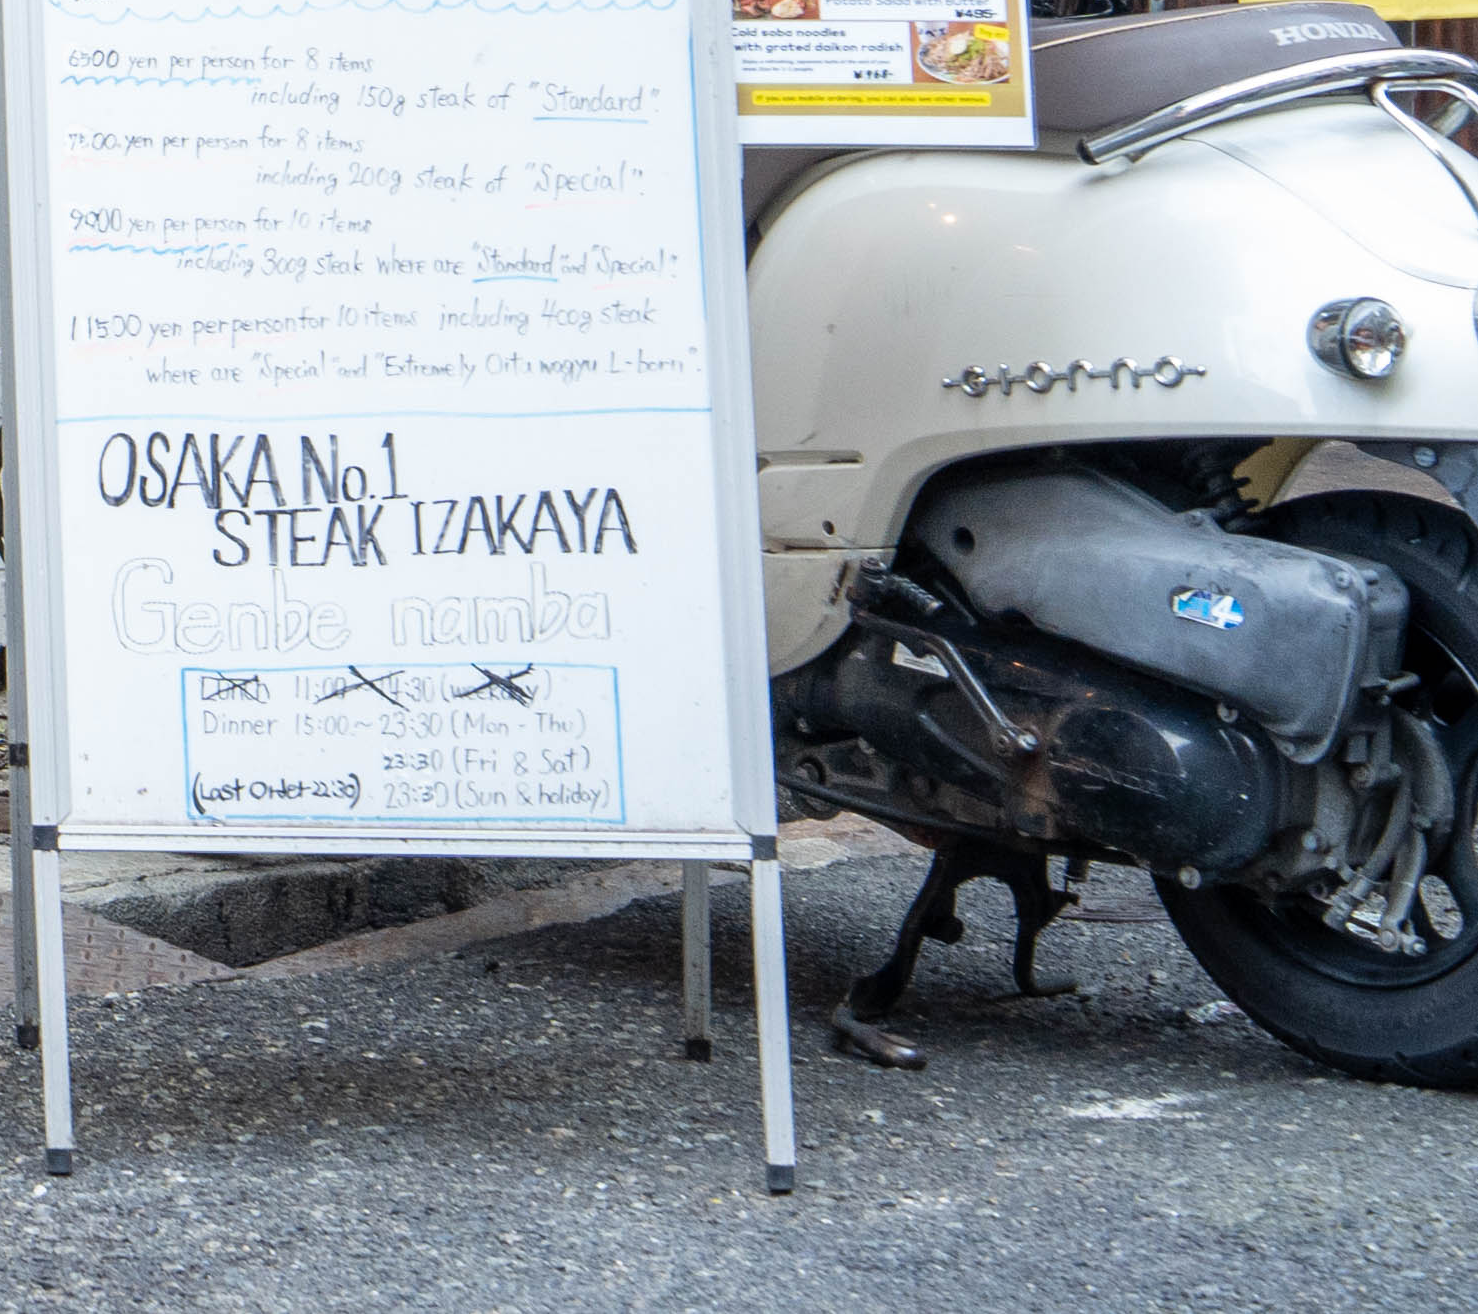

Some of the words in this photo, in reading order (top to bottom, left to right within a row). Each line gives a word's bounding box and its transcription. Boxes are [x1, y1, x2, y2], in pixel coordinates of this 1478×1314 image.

[796, 28, 846, 37] noodles
[1269, 19, 1386, 48] HONDA
[765, 43, 811, 53] grated
[815, 43, 857, 52] daikon
[861, 43, 903, 52] radish
[251, 85, 341, 113] including
[417, 85, 476, 109] steak
[487, 83, 514, 109] of
[99, 431, 285, 511] OSAKA
[301, 432, 409, 505] No.1
[213, 505, 389, 567] STEAK
[409, 486, 638, 557] IZAKAYA
[112, 557, 352, 654] Genbe
[392, 562, 613, 647] namba
[202, 711, 278, 736] Dinner
